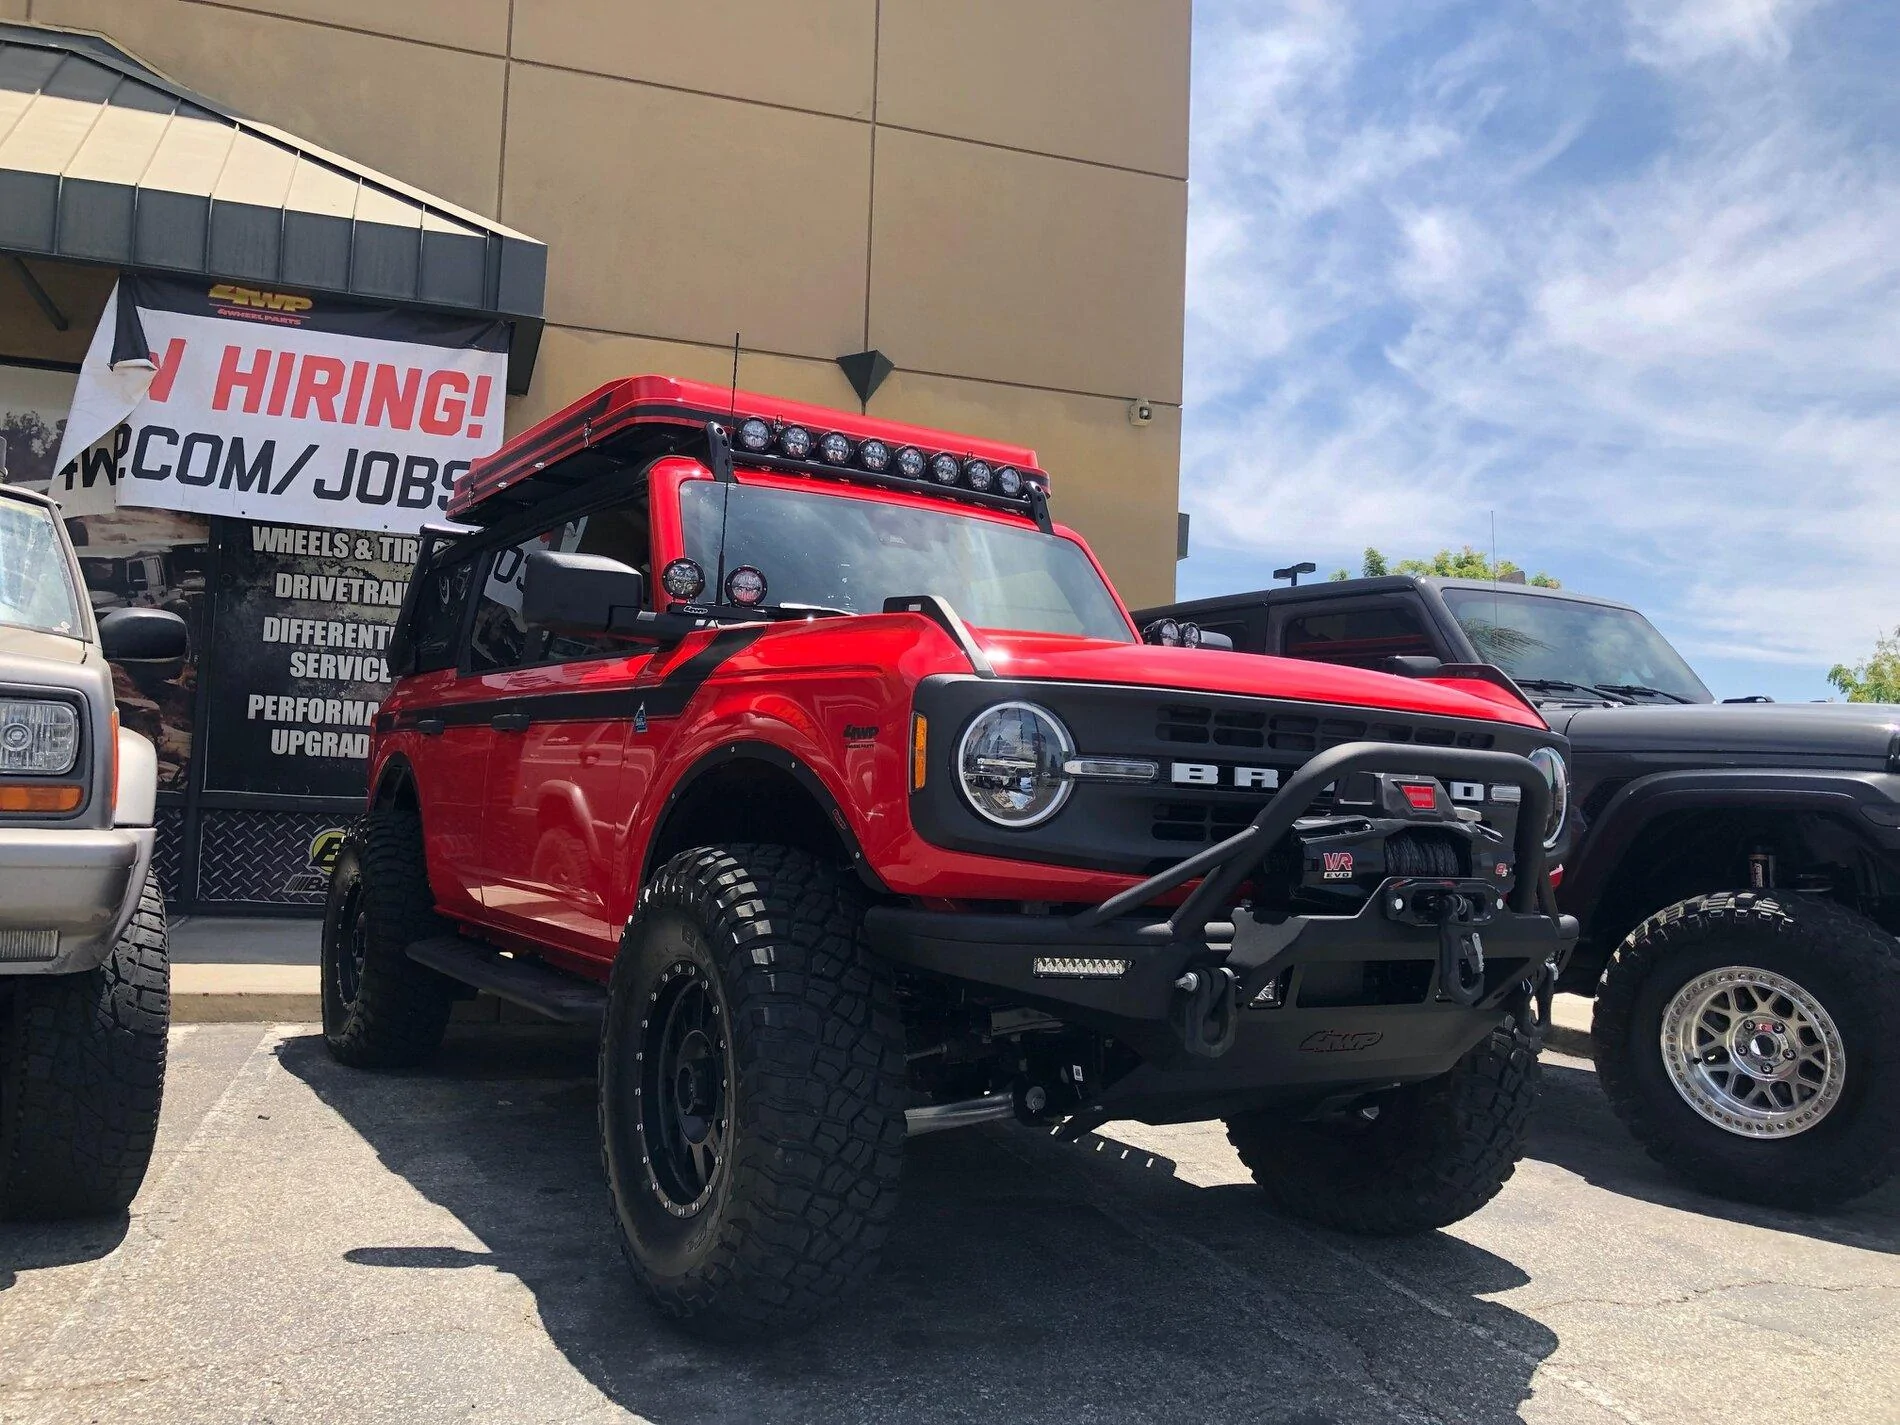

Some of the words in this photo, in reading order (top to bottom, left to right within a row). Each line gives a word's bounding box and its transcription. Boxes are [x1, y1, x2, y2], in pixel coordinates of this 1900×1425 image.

[212, 345, 492, 438] HIRING!
[252, 526, 349, 559] WHEELS
[354, 538, 373, 561] &
[379, 537, 422, 564] TIR
[262, 616, 396, 650] DIFFERENT
[247, 694, 380, 727] PERFORMA
[271, 729, 370, 759] UPGRAD
[1323, 852, 1353, 871] VR
